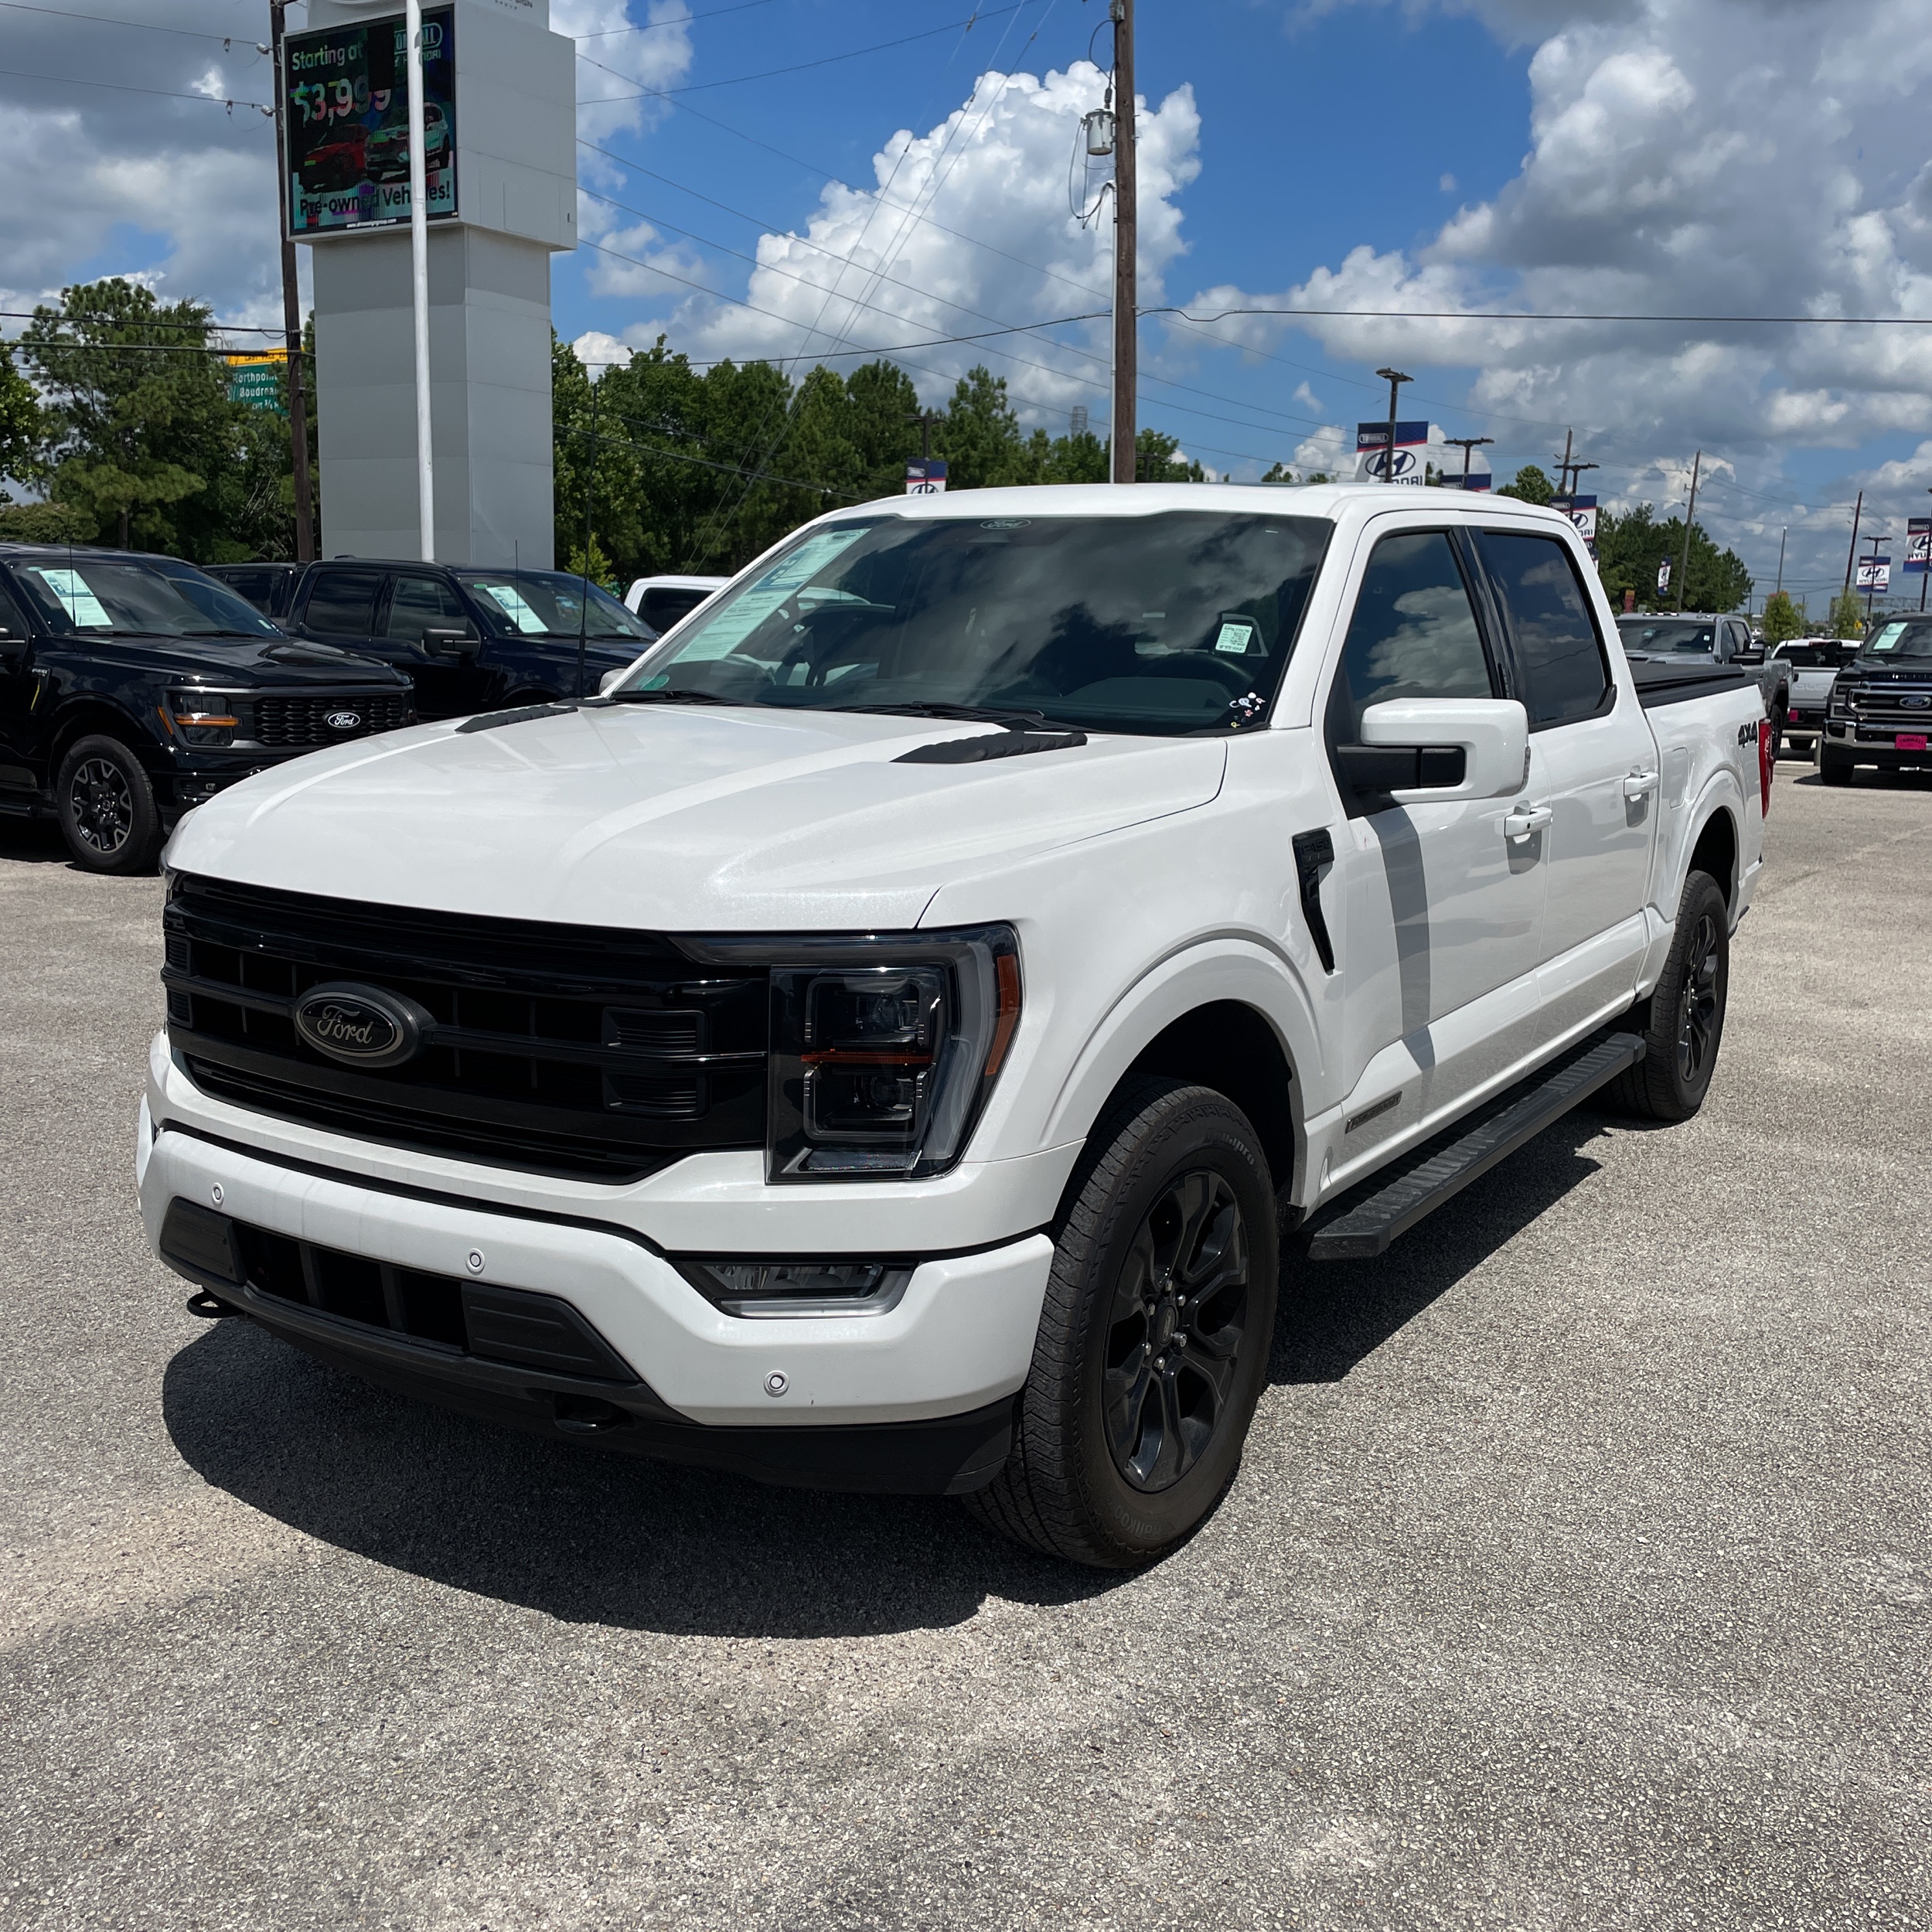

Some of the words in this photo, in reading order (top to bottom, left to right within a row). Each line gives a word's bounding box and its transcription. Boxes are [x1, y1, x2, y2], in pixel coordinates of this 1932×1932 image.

[292, 45, 345, 71] Starting
[301, 190, 380, 216] Pre-owned
[383, 180, 450, 206] Vehles!
[334, 714, 355, 726] Ford
[317, 1005, 374, 1044] Ford
